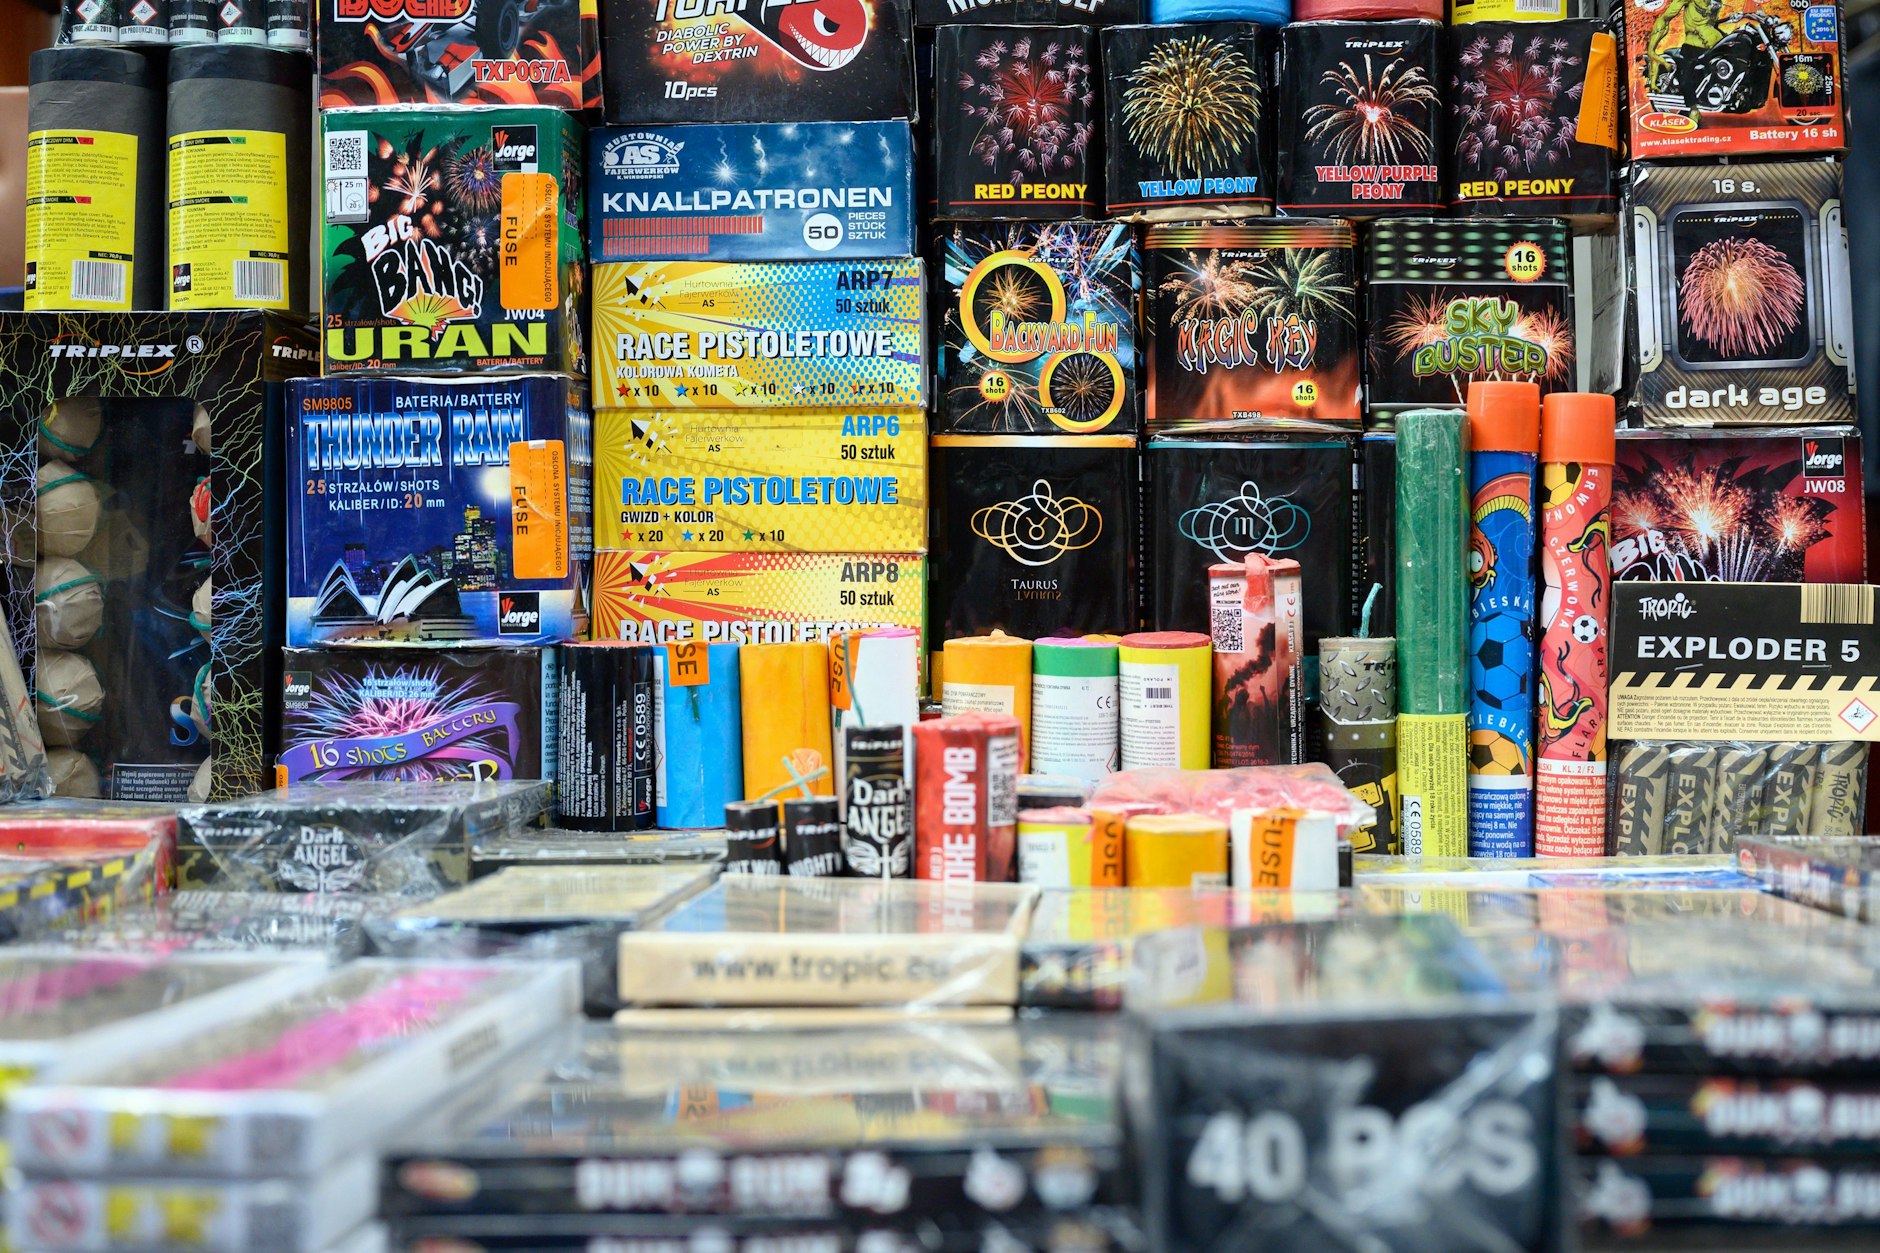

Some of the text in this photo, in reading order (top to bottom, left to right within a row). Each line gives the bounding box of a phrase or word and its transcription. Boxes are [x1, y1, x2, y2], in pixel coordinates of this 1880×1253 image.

[656, 22, 730, 43] DIABOLIC
[662, 34, 745, 55] POWER BY
[692, 45, 759, 64] DEXTRIN
[1793, 54, 1813, 64] 16m
[472, 59, 571, 83] TXP067A
[664, 81, 717, 100] 10pcs
[1824, 75, 1834, 95] 25m
[1796, 109, 1807, 117] 20
[1649, 117, 1686, 128] KLASEK
[605, 132, 675, 151] HURTOWNIA
[1640, 135, 1732, 148] www.klasektrading.cz
[1750, 127, 1837, 140] Battery 16 sh
[496, 143, 536, 161] Jorge
[622, 145, 660, 164] AS
[604, 166, 679, 175] FAJERWERKÓW
[1315, 165, 1437, 182] YELLOW/PURPLE
[974, 183, 1087, 199] RED PEONY
[1138, 176, 1258, 198] YELLOW PEONY
[1351, 183, 1405, 199] PEONY
[1459, 178, 1575, 198] RED PEONY
[1712, 179, 1735, 194] 16
[603, 187, 892, 212] KNALLPATRONEN
[848, 212, 886, 220] PIECES
[808, 226, 839, 239] 50
[848, 220, 886, 230] STÜCK
[361, 214, 415, 261] BIG
[505, 217, 518, 267] FUSE
[848, 231, 886, 240] SZTUK
[1514, 251, 1536, 262] 16
[1512, 264, 1538, 272] shots
[371, 238, 484, 319] BANG!
[836, 271, 894, 290] ARP7
[702, 299, 715, 308] AS
[836, 299, 890, 314] 50 sztuk
[328, 314, 342, 328] 25
[504, 309, 545, 321] JW04
[1446, 297, 1519, 337] SKY
[327, 322, 548, 361] URAN
[616, 330, 893, 360] RACE PISTOLETOWE
[1177, 307, 1318, 374] MAGIC KEY
[476, 357, 544, 367] BATERIA/BATTERY
[1412, 336, 1548, 377] BUSTER
[367, 360, 381, 370] 20
[382, 362, 397, 370] mm
[616, 365, 740, 379] KOLOROWA KOMETA
[702, 383, 718, 396] 10
[760, 383, 776, 396] 10
[819, 382, 835, 395] 10
[878, 382, 894, 394] 10
[987, 376, 1004, 387] 16
[1298, 385, 1313, 394] 16
[644, 384, 659, 397] 10
[1665, 383, 1827, 411] dark age
[303, 397, 353, 411] SM9805
[1232, 411, 1261, 419] TXB498
[842, 415, 900, 437] ARP6
[303, 409, 524, 471] THUNDER RAIN
[708, 444, 721, 452] AS
[841, 444, 895, 460] 50 sztuk
[1806, 452, 1843, 470] Jorge
[306, 480, 326, 495] 25
[621, 476, 898, 505] RACE PISTOLETOWE
[1804, 480, 1845, 493] JW08
[404, 494, 423, 509] 20
[426, 497, 445, 508] mm
[514, 486, 528, 536] FUSE
[621, 511, 714, 523] GWIZD KOLOR
[648, 530, 663, 542] 20
[708, 530, 724, 542] 20
[769, 530, 785, 542] 10
[1610, 530, 1667, 573] BIG
[840, 562, 899, 583] ARP8
[707, 588, 720, 596] AS
[840, 590, 894, 606] 50 sztuk
[501, 611, 538, 627] Jorge
[1637, 636, 1861, 662] EXPLODER 5
[635, 693, 647, 735] 0589
[309, 741, 340, 769] 16
[943, 747, 977, 826] BOMB
[1410, 821, 1422, 855] 0589
[1188, 1108, 1305, 1201] 40
